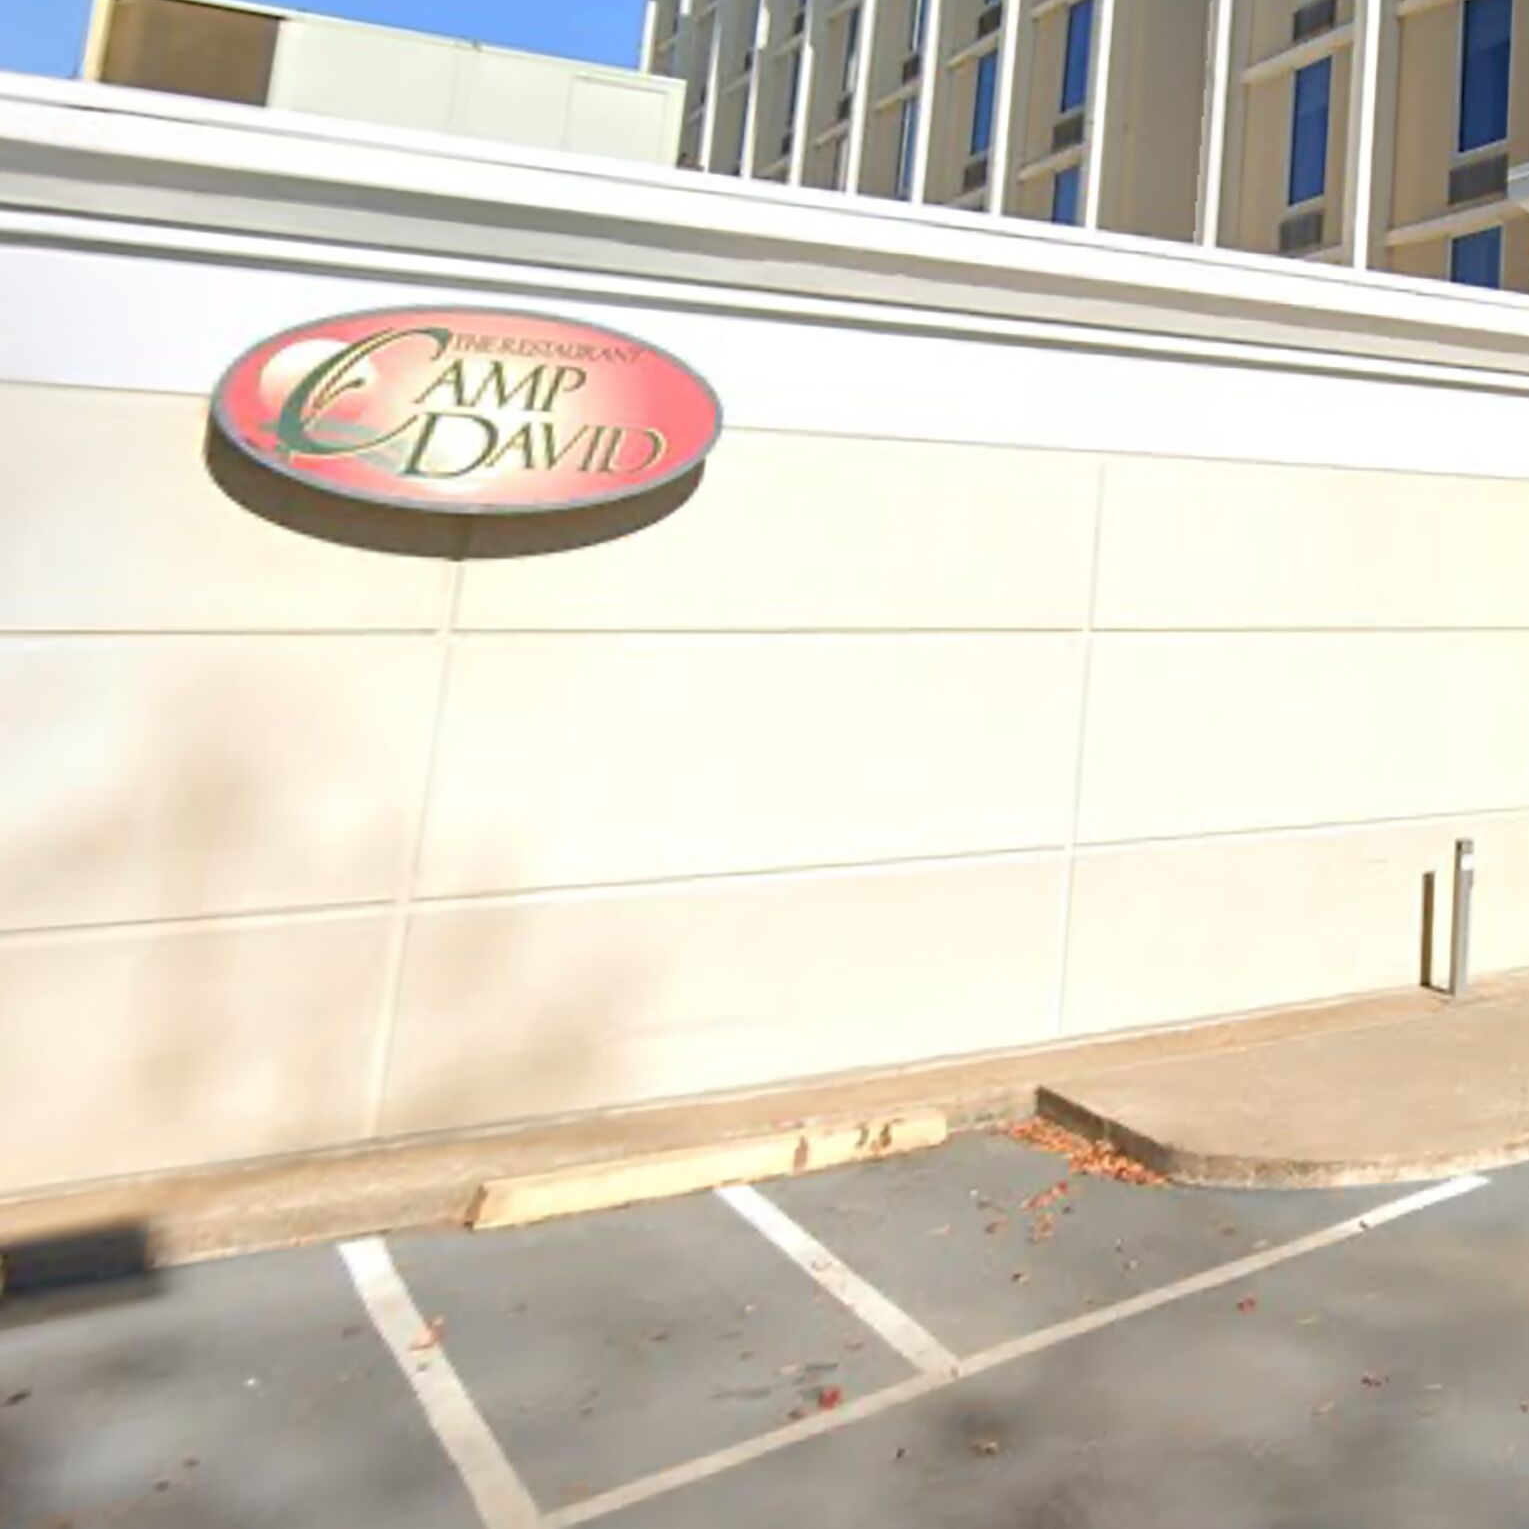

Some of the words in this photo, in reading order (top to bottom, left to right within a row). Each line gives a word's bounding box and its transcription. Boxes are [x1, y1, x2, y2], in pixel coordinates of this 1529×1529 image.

[452, 332, 490, 353] THE
[499, 337, 643, 364] RESTAURANT
[276, 326, 588, 456] CAMP
[400, 411, 669, 480] DAVID
